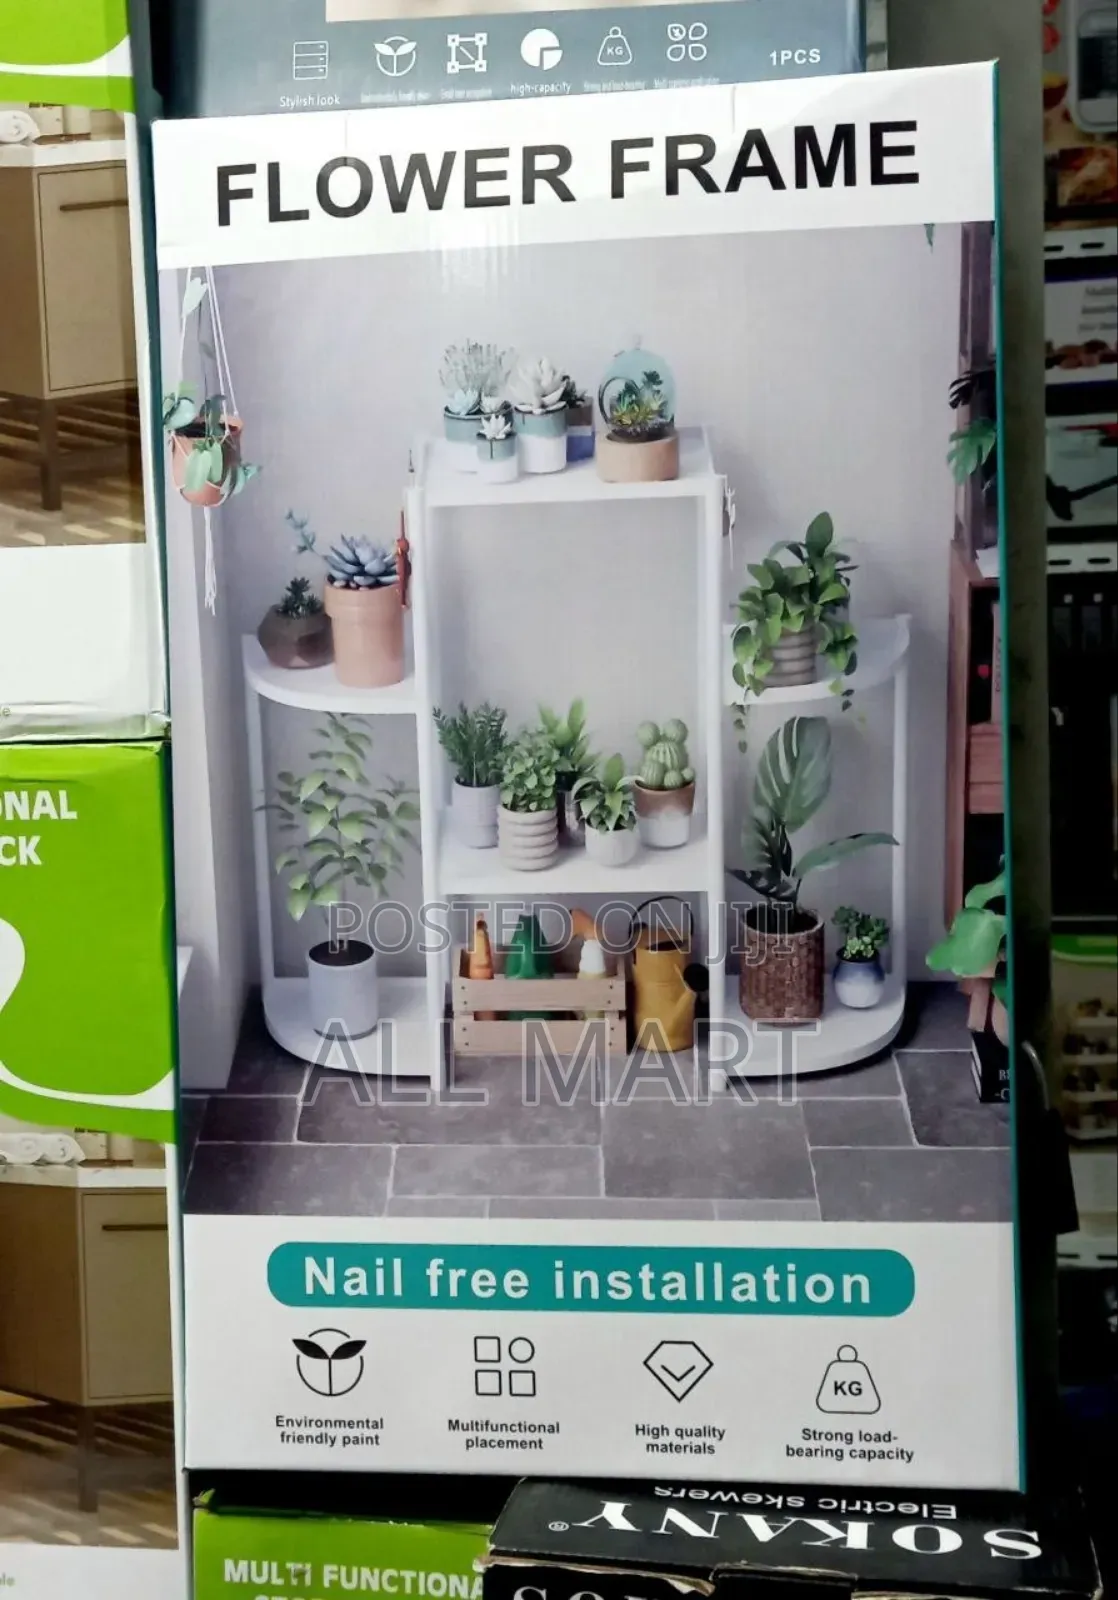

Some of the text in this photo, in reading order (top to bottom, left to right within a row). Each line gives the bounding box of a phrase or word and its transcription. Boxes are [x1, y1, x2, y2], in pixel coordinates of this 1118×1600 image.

[606, 45, 624, 56] KG
[769, 48, 822, 66] 1PCS
[510, 81, 572, 96] high-capacity
[279, 94, 341, 110] Stylish look
[216, 120, 920, 227] FLOWER FRAME
[0, 789, 78, 821] NAL
[304, 1256, 871, 1304] Nail free installation
[833, 1380, 864, 1397] KG
[275, 1415, 385, 1431] Environmental
[447, 1419, 560, 1435] Multifunctional
[280, 1431, 380, 1448] friendly paint
[634, 1423, 726, 1443] High quality
[801, 1428, 899, 1445] Strong load-
[465, 1435, 544, 1452] placement
[645, 1441, 716, 1456] materials
[785, 1445, 915, 1464] bearing capacity
[654, 1485, 957, 1520] Electric skewers
[571, 1500, 1043, 1560] SOKANY
[223, 1558, 311, 1587] MULTI
